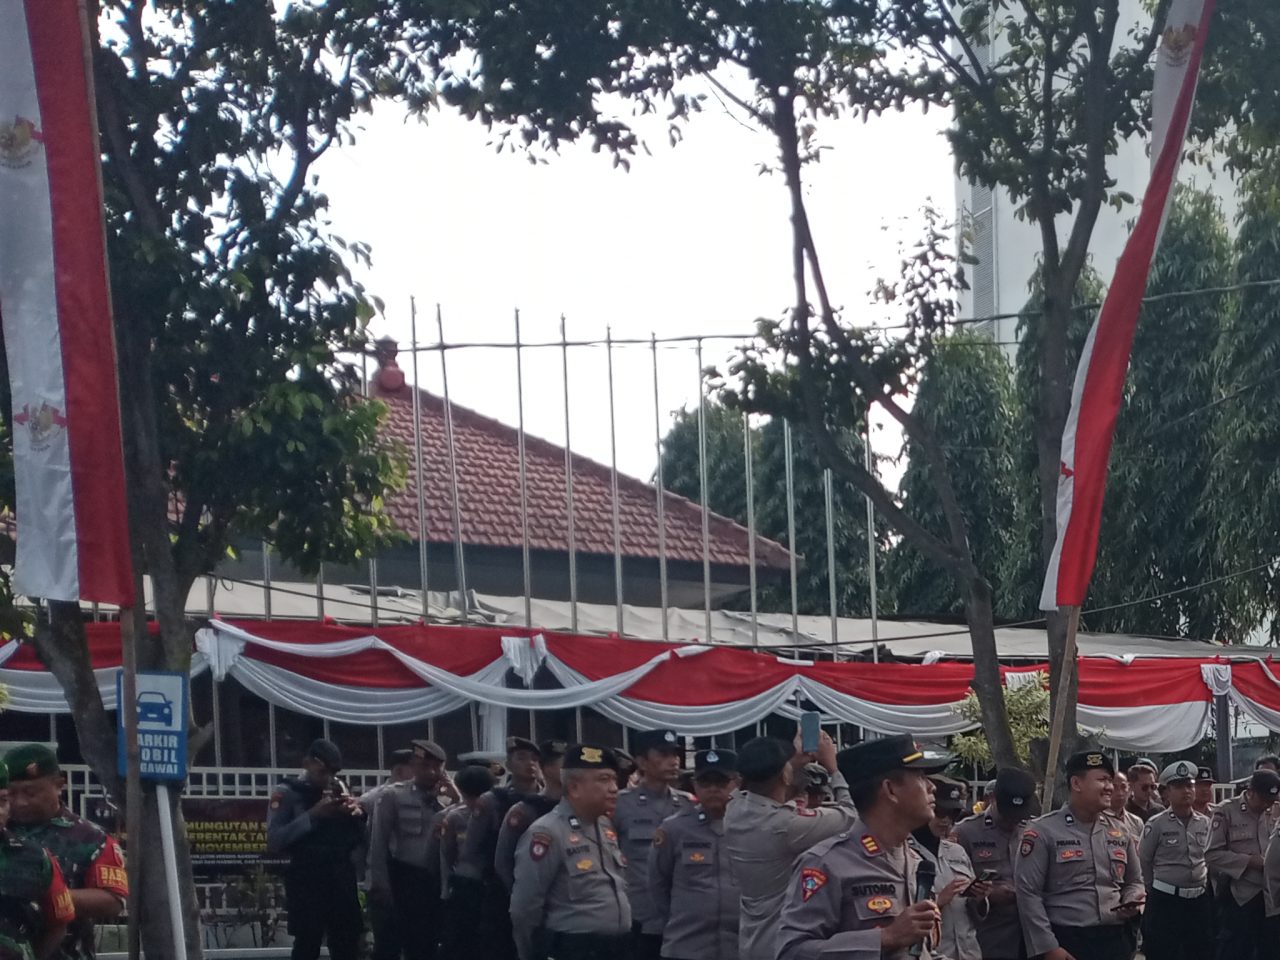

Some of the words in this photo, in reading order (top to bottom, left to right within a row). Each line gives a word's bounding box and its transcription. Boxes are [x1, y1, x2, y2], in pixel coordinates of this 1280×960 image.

[137, 734, 179, 749] ARKIR
[141, 748, 179, 763] OBIL
[140, 763, 179, 775] GAWAI
[184, 821, 259, 831] MUNGUTAN
[188, 832, 248, 841] ERENTAK
[851, 883, 896, 896] SUTOMO
